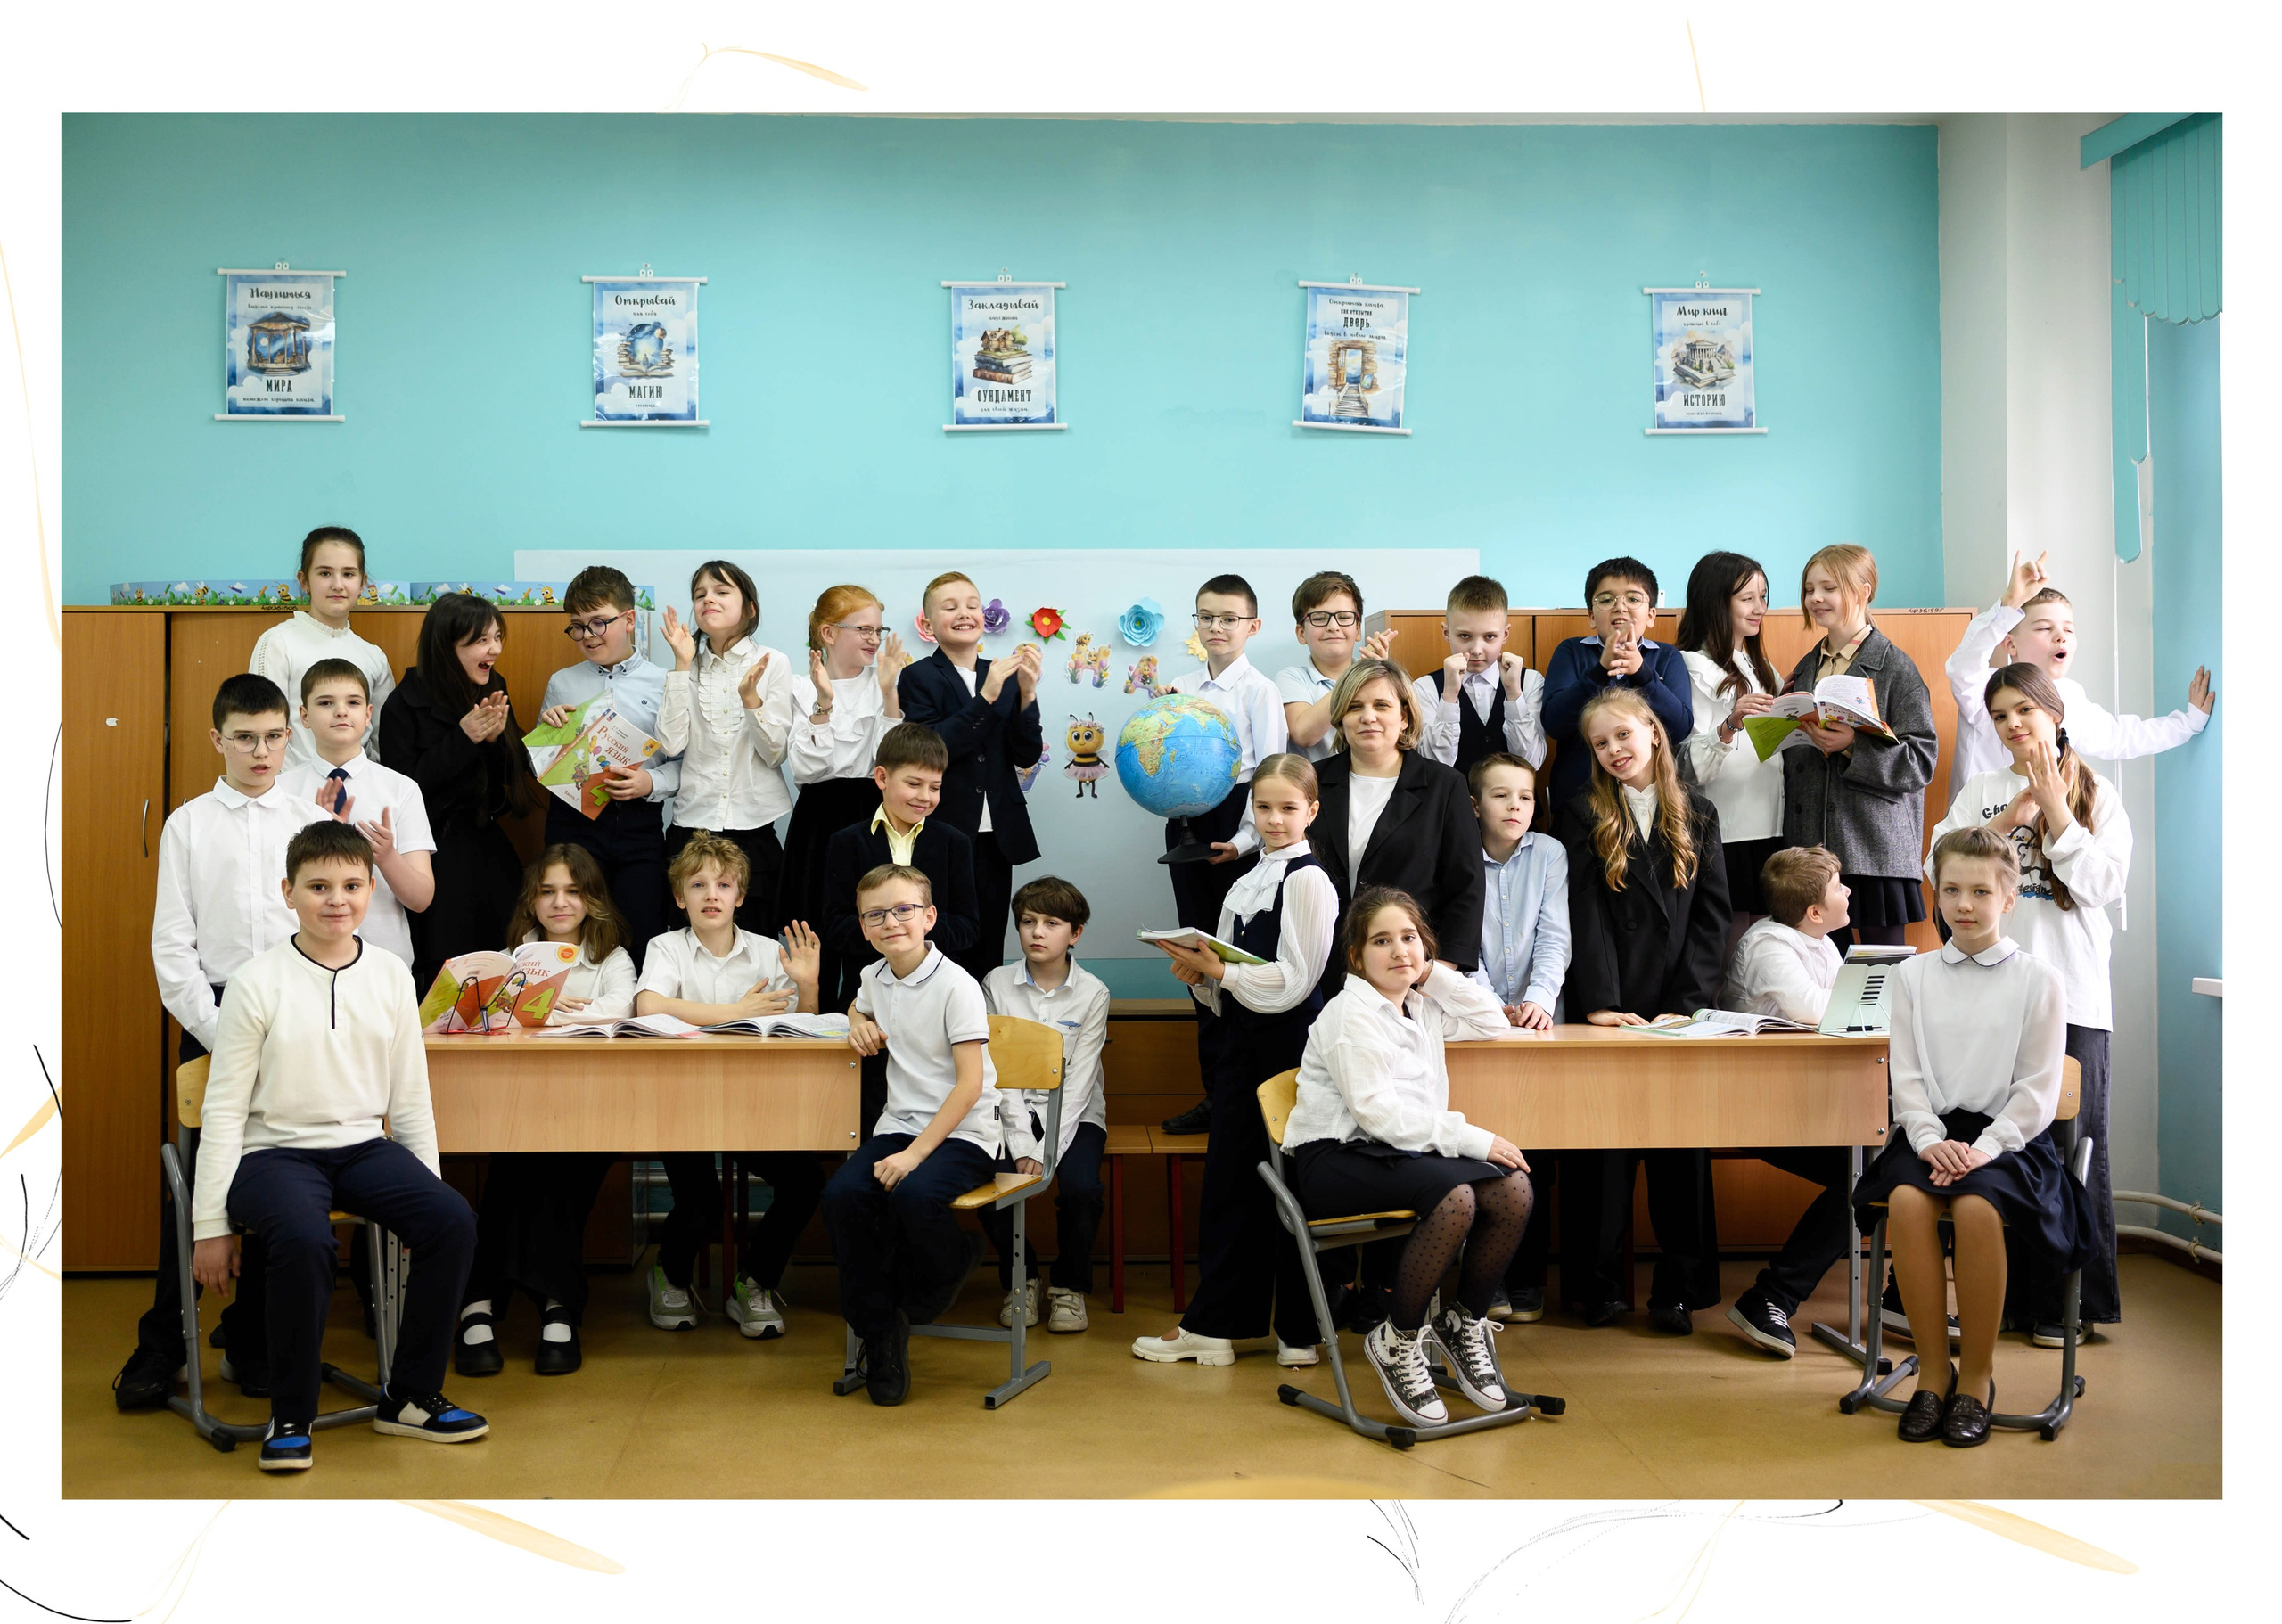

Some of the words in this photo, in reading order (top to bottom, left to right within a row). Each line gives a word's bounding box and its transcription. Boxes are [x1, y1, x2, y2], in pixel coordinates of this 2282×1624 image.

[249, 287, 312, 299] Научиться
[614, 294, 677, 308] Открывай
[967, 299, 1039, 311] Закладывай
[1676, 305, 1700, 318] Мир
[1703, 307, 1729, 316] книг
[266, 379, 293, 392] МИРА
[628, 385, 663, 398] МАГИЮ
[1683, 393, 1727, 407] ИСТОРИЮ
[1982, 803, 2007, 820] Gho
[2017, 882, 2054, 897] designe
[521, 987, 556, 1020] 4
